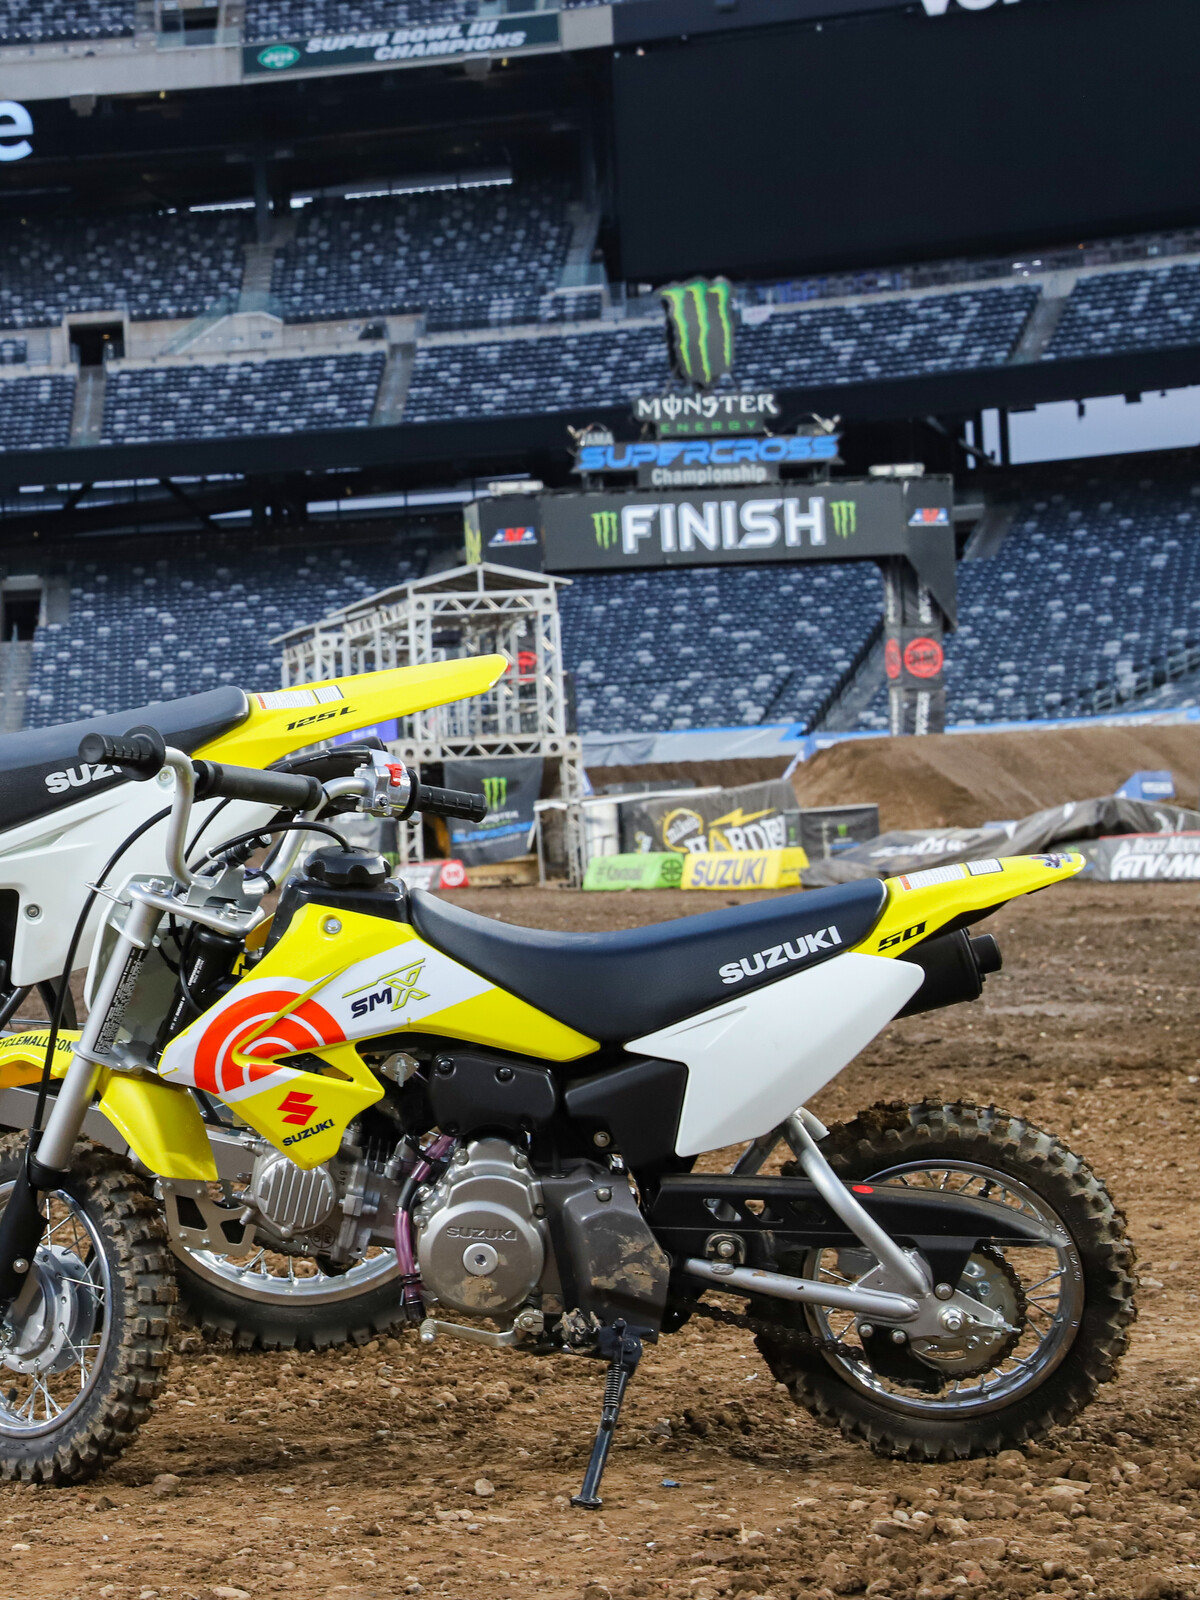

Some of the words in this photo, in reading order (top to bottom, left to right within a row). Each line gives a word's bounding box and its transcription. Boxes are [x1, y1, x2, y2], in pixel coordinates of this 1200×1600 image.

[306, 36, 388, 53] SUPER
[392, 24, 464, 45] BOWL
[467, 20, 499, 36] III
[374, 31, 527, 61] CHAMPIONS
[638, 393, 778, 420] MONSTER
[660, 421, 757, 434] ENERGY
[578, 435, 839, 470] SUPERCROSS
[651, 464, 768, 486] Championship
[621, 497, 827, 554] FINISH
[44, 763, 123, 794] SUZ
[691, 858, 768, 886] SUZUKI
[877, 920, 927, 952] 50
[719, 926, 842, 984] SUZUKI
[351, 965, 431, 1019] SMX
[282, 1119, 335, 1147] SUZUKI
[446, 1226, 518, 1241] SUZUKI
